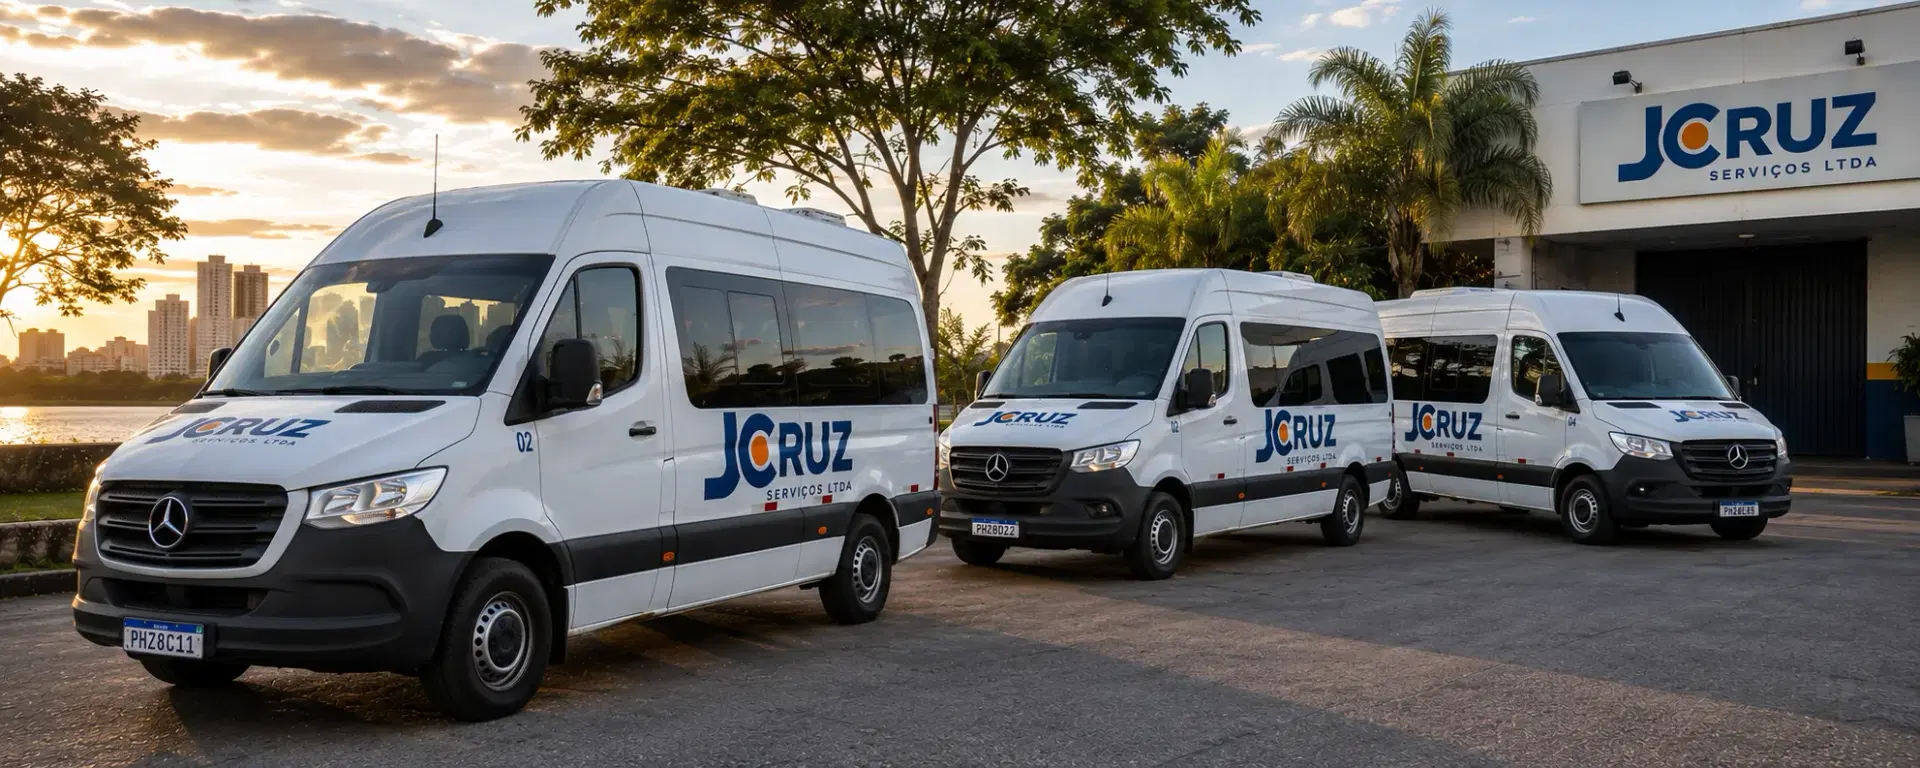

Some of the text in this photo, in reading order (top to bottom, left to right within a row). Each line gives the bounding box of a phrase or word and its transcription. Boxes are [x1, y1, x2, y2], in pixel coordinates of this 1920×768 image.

[1618, 91, 1878, 183] JCRUZ
[1709, 155, 1877, 181] SERVIÇOS LTDA
[144, 416, 332, 445] JCRUZ
[973, 410, 1078, 427] JCRUZ
[1404, 402, 1483, 442] JCRUZ
[516, 431, 534, 453] 02
[1256, 408, 1337, 463] JCRUZ
[704, 411, 853, 501] JCRUZ
[766, 480, 853, 501] SERVIÇOS LTDA
[130, 629, 195, 655] PHZ8C11
